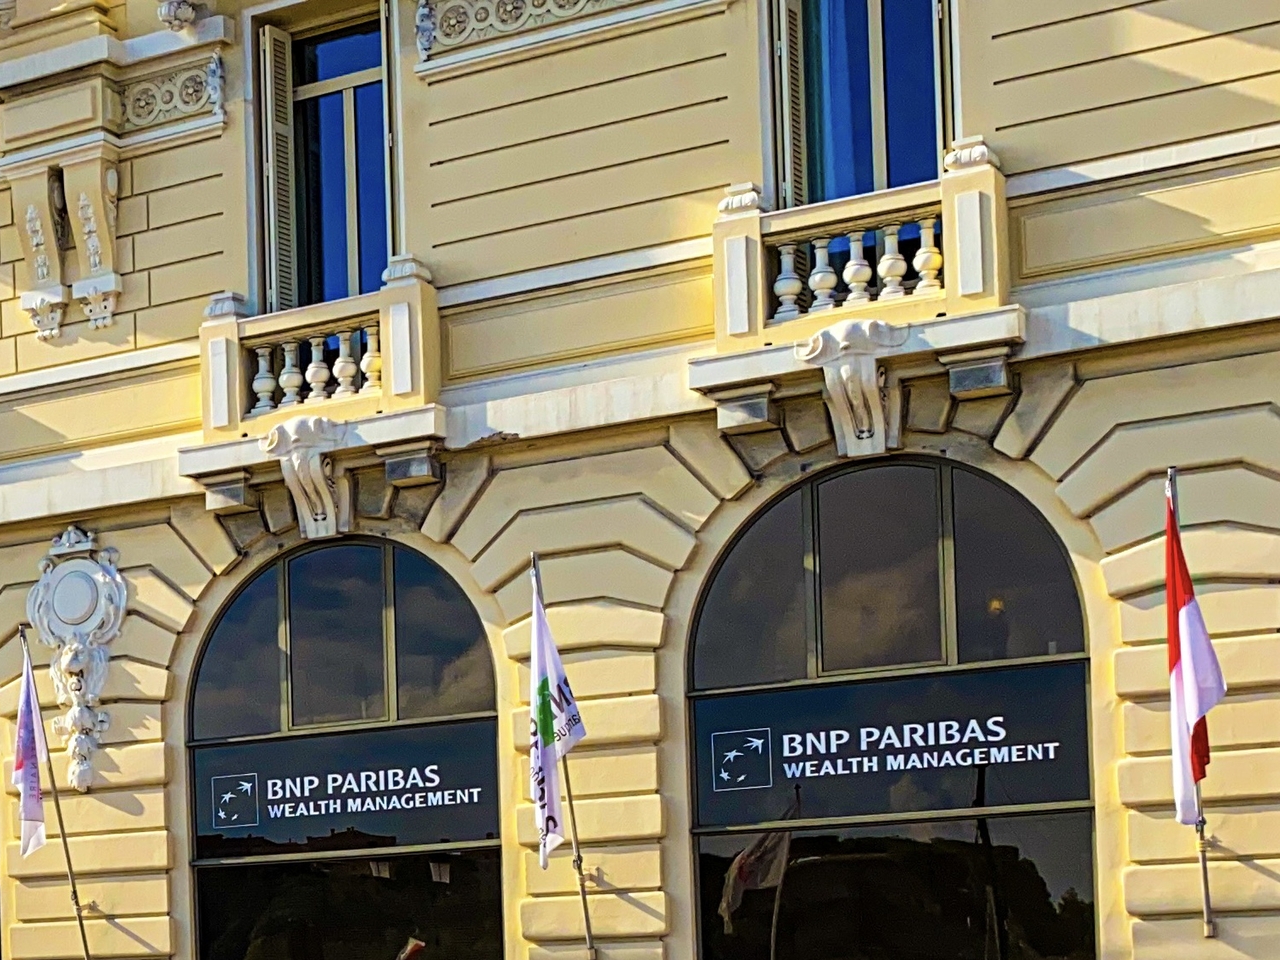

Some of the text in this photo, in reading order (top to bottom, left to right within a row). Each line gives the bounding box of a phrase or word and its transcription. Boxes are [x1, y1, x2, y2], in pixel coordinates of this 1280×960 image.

[782, 716, 1006, 757] BNP PARIBAS
[783, 742, 1060, 778] WEALTH MANAGEMENT
[267, 765, 440, 799] BNP PARIBAS
[267, 787, 482, 818] WEALTH MANAGEMENT
